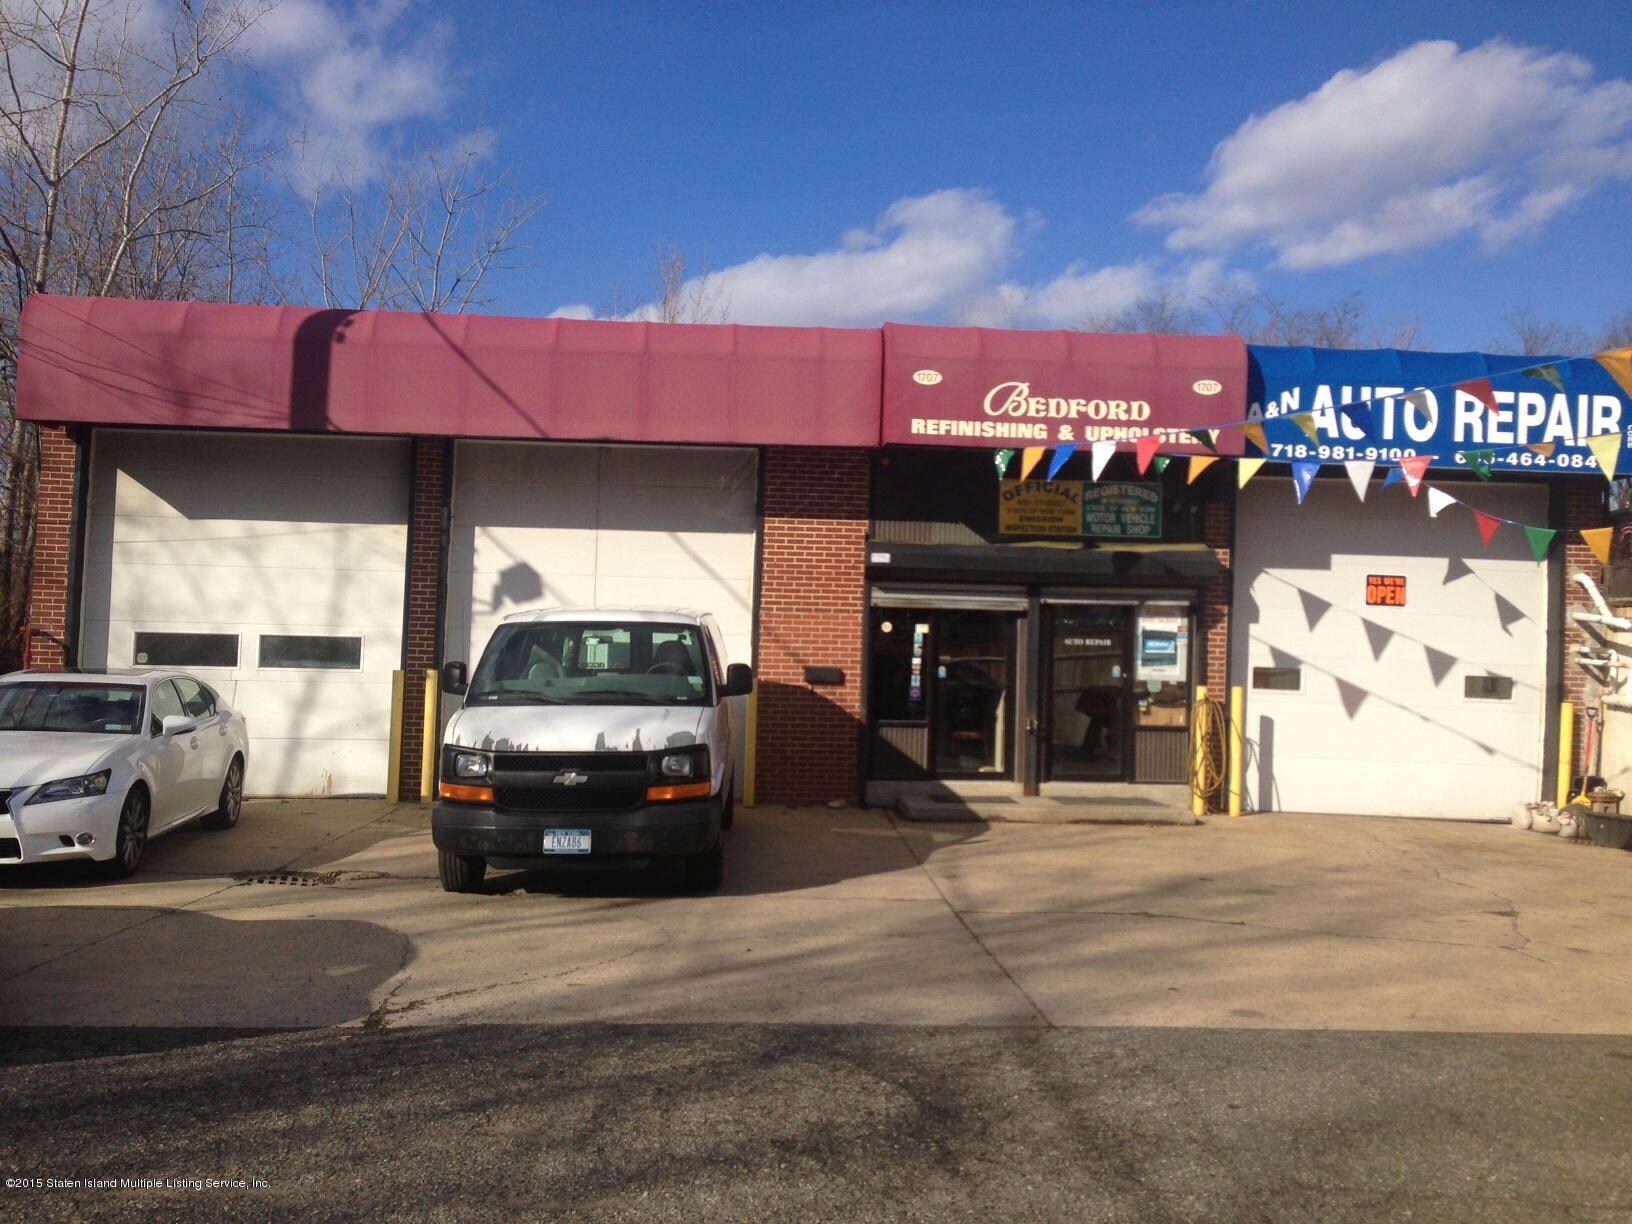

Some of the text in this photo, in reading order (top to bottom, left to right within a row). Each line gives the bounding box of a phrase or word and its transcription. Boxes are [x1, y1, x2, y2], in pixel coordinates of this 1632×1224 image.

[916, 372, 939, 382] 1707
[1197, 382, 1219, 392] 1707
[983, 381, 1151, 421] BEDFORD
[1247, 384, 1622, 447] A&N AUTO REPAIR
[911, 418, 1048, 440] REFINISHING
[1058, 424, 1075, 441] &
[1271, 444, 1417, 461] 718-981-9100
[1455, 451, 1598, 469] 6-464-084
[1002, 481, 1080, 505] OFFICIAL
[1085, 485, 1158, 502] REGISTERED
[1086, 512, 1156, 525] MOTOR VEHICLE
[1090, 523, 1151, 536] REPAIR SHOP
[1367, 585, 1405, 605] OPEN
[1064, 638, 1112, 646] AUTO REPAIR
